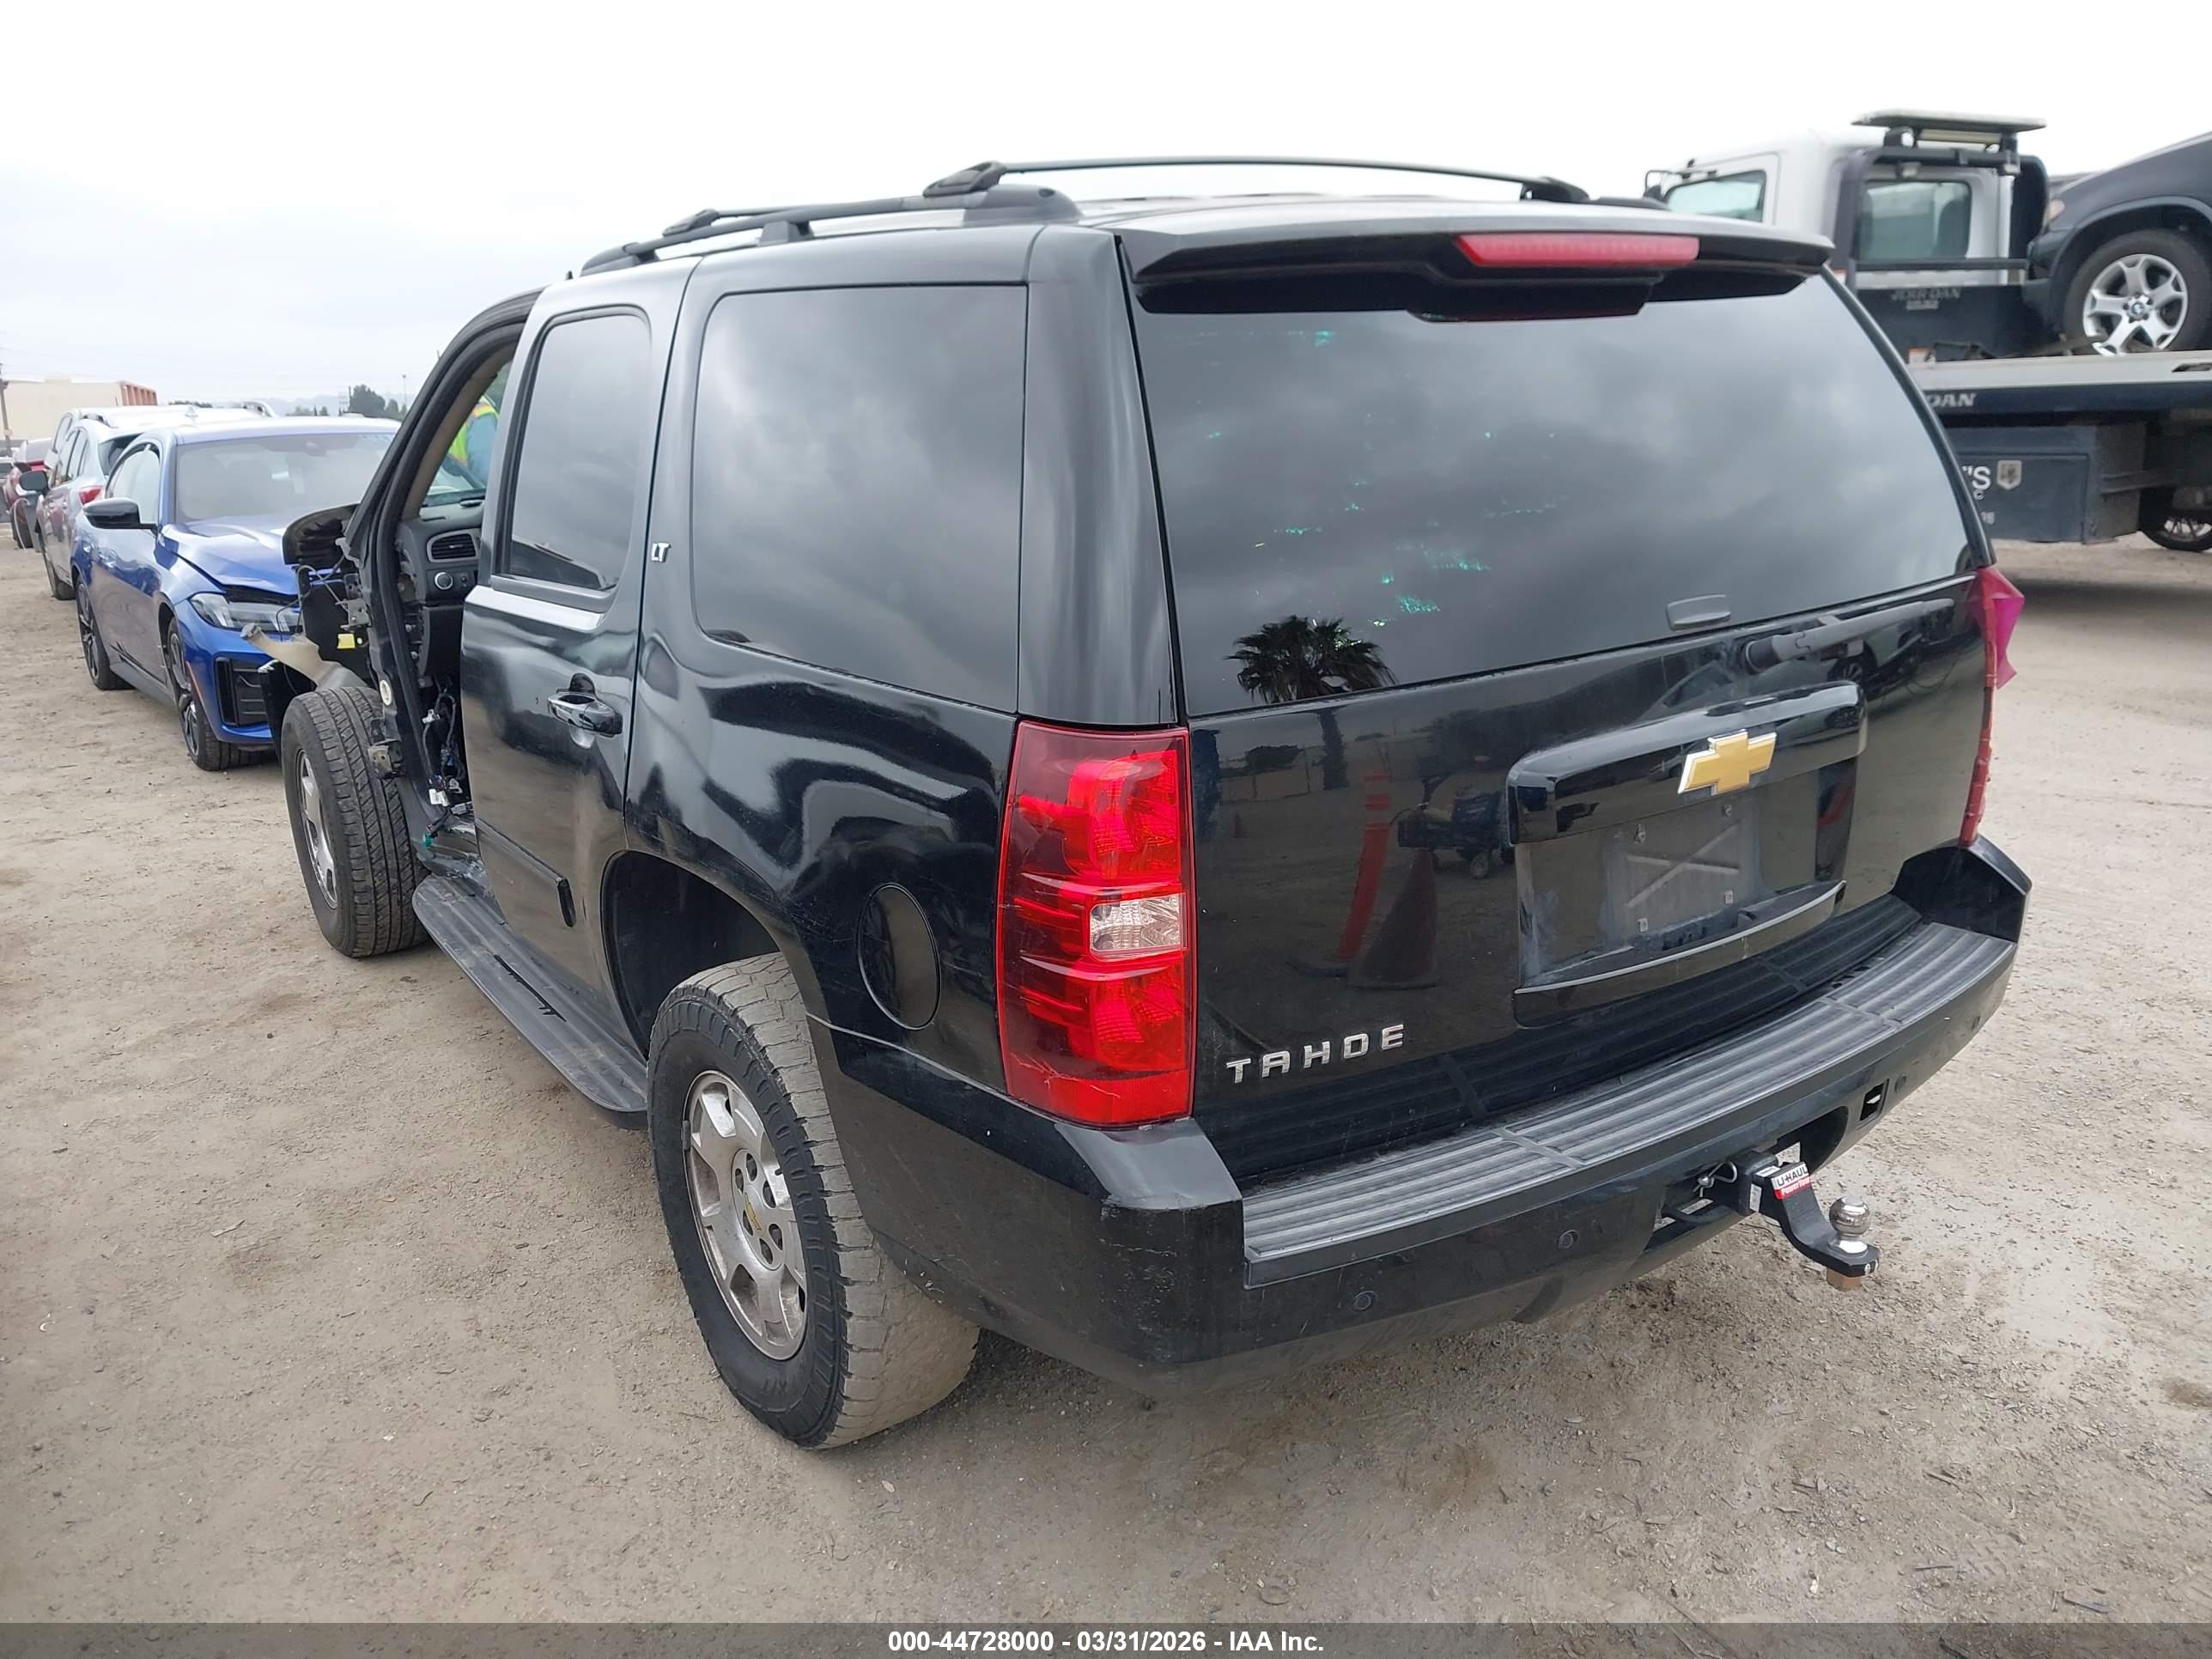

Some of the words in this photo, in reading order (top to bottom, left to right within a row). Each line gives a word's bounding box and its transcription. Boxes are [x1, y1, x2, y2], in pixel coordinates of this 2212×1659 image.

[651, 542, 671, 562] LT
[1226, 1024, 1404, 1084] TAHOE
[1777, 1166, 1808, 1187] U-HAUL
